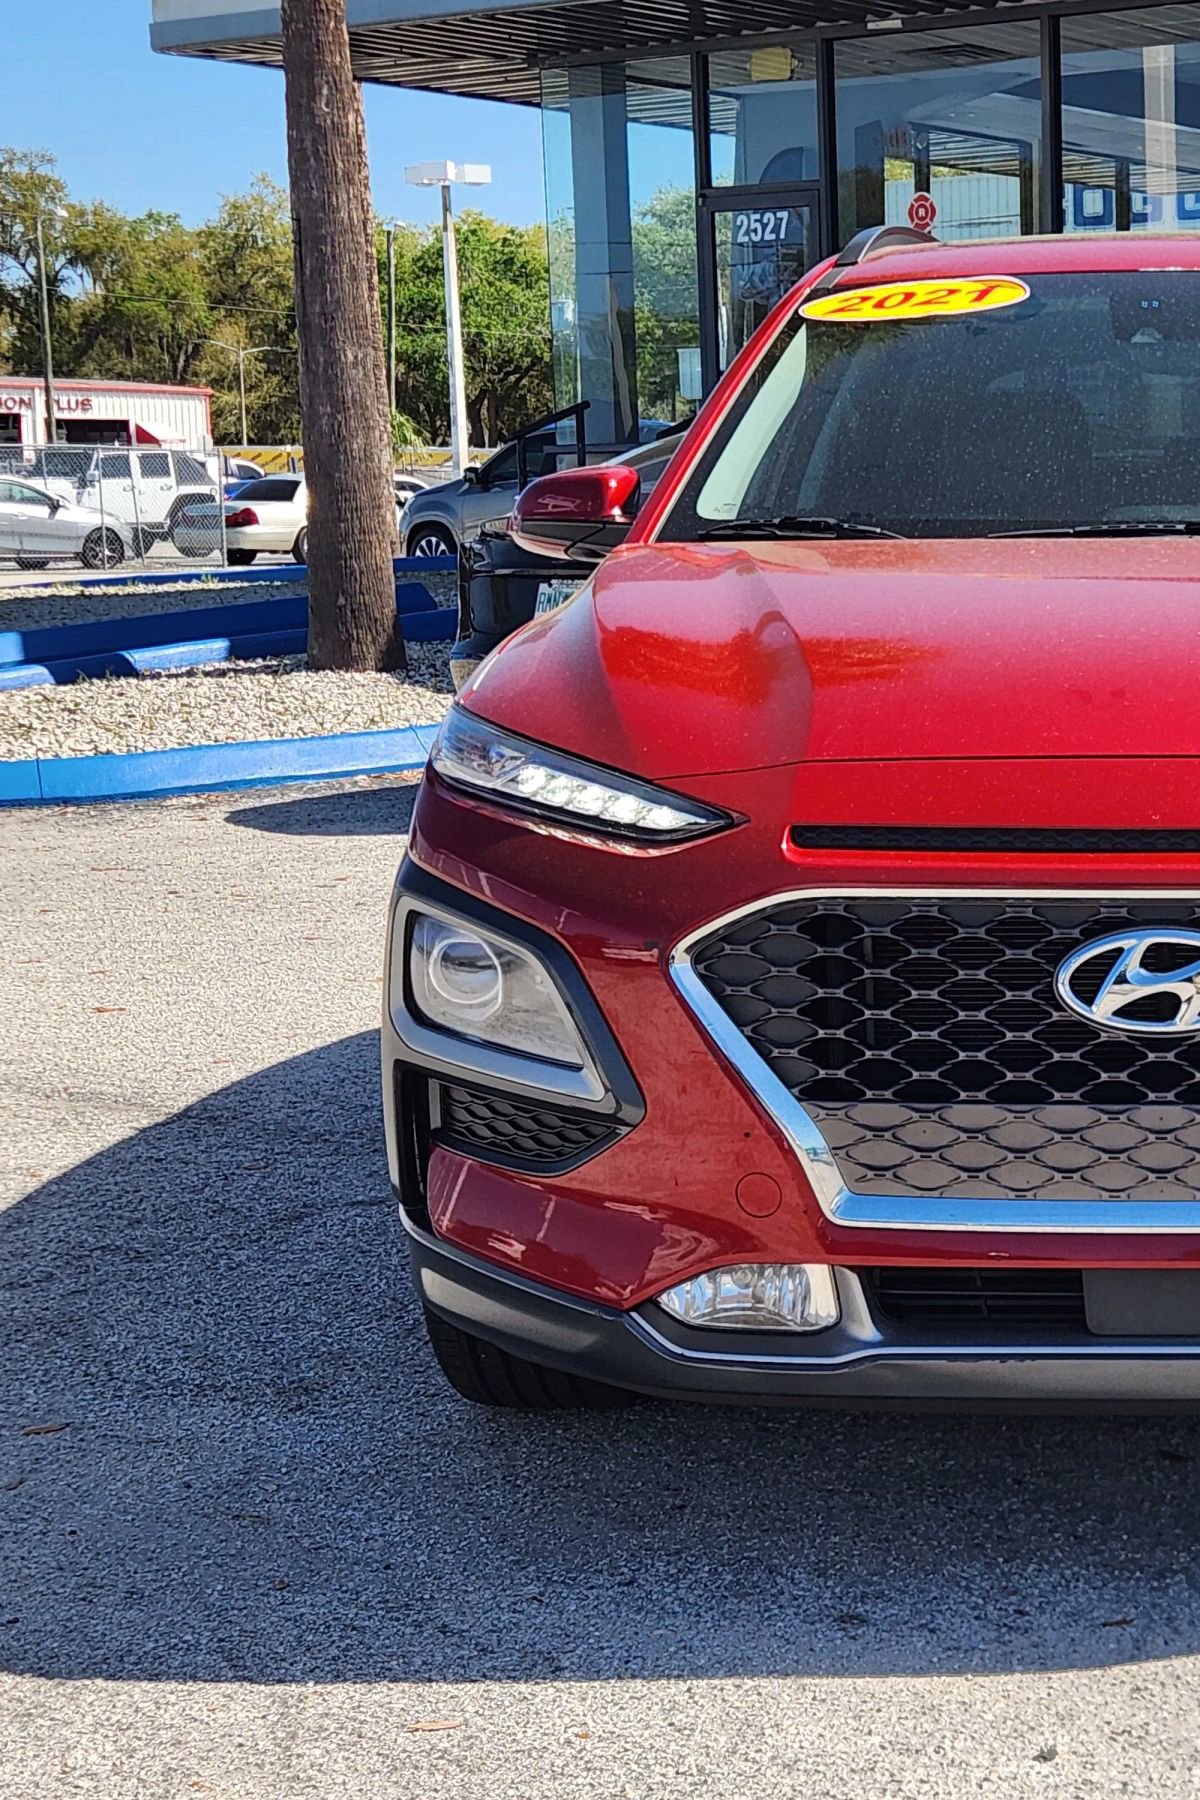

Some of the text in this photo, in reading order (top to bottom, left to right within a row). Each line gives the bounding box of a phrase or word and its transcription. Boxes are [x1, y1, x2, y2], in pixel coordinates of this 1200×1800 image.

[736, 211, 788, 243] 2527
[823, 285, 1000, 316] 2021
[53, 397, 93, 412] LUS
